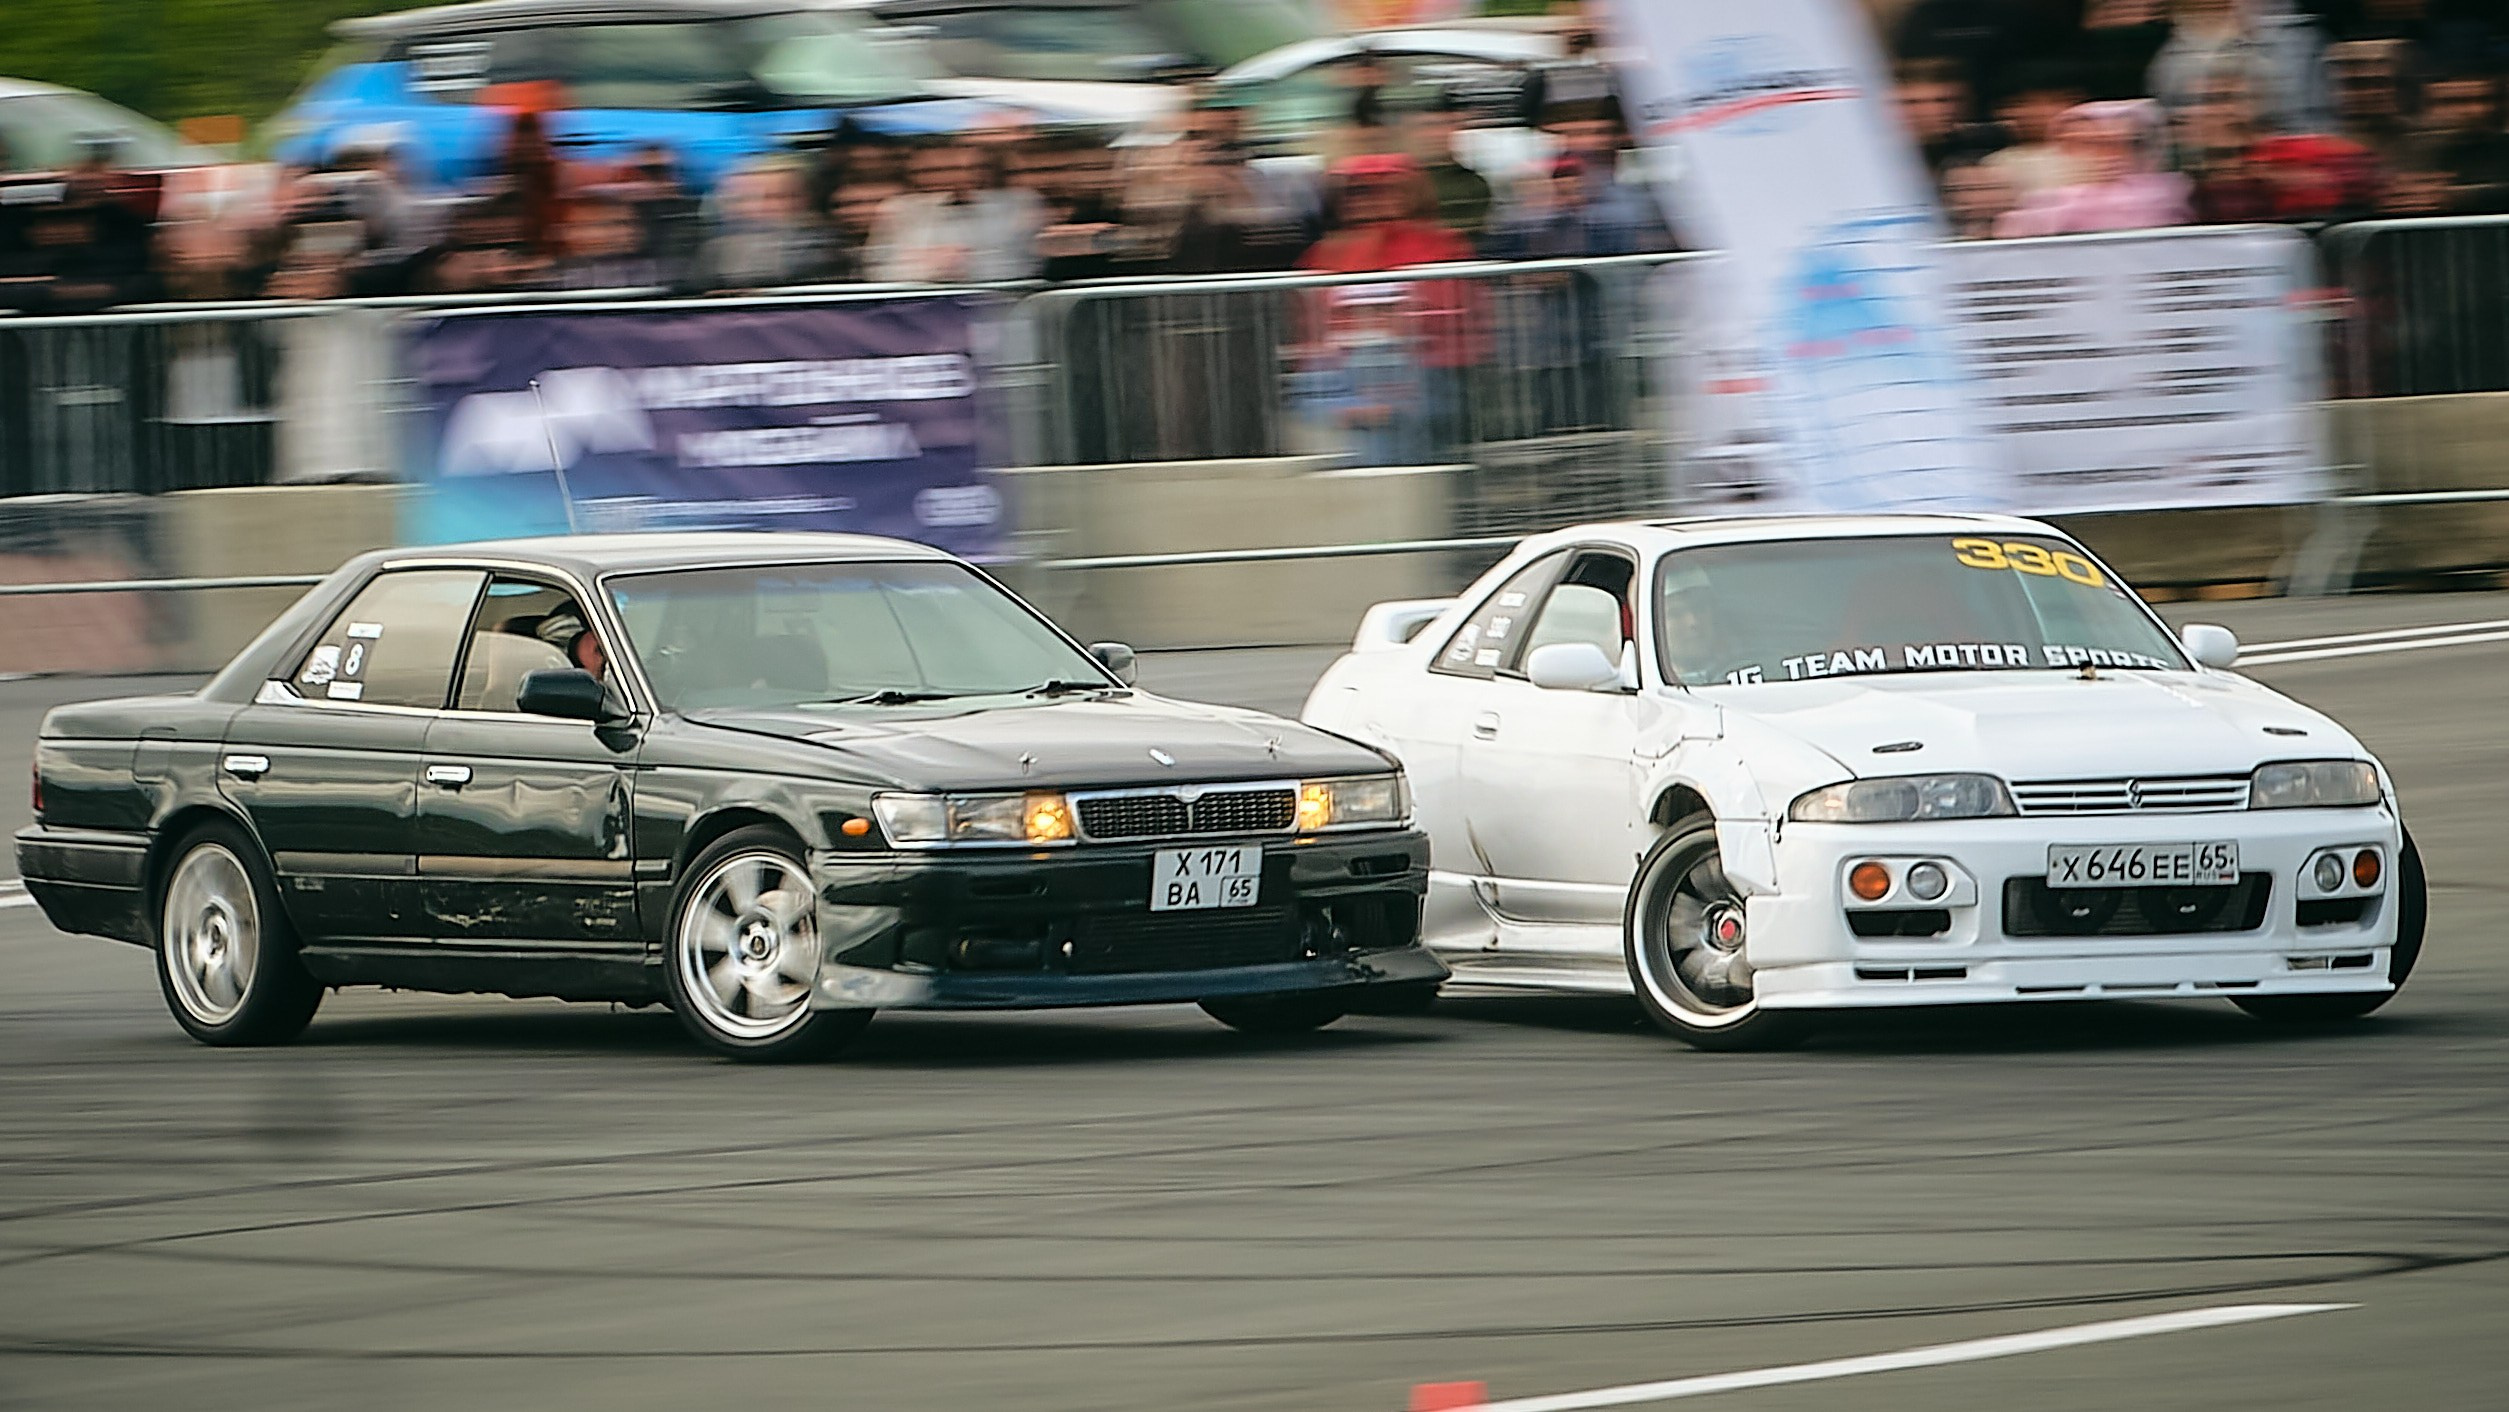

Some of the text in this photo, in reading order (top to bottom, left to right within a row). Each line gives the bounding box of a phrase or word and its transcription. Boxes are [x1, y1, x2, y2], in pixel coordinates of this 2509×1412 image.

[1952, 538, 2105, 588] 330
[345, 643, 364, 675] 8
[1782, 647, 1887, 680] TEAM
[1903, 644, 2029, 668] MOTOR
[2200, 845, 2228, 870] 65
[1229, 879, 1252, 898] 65
